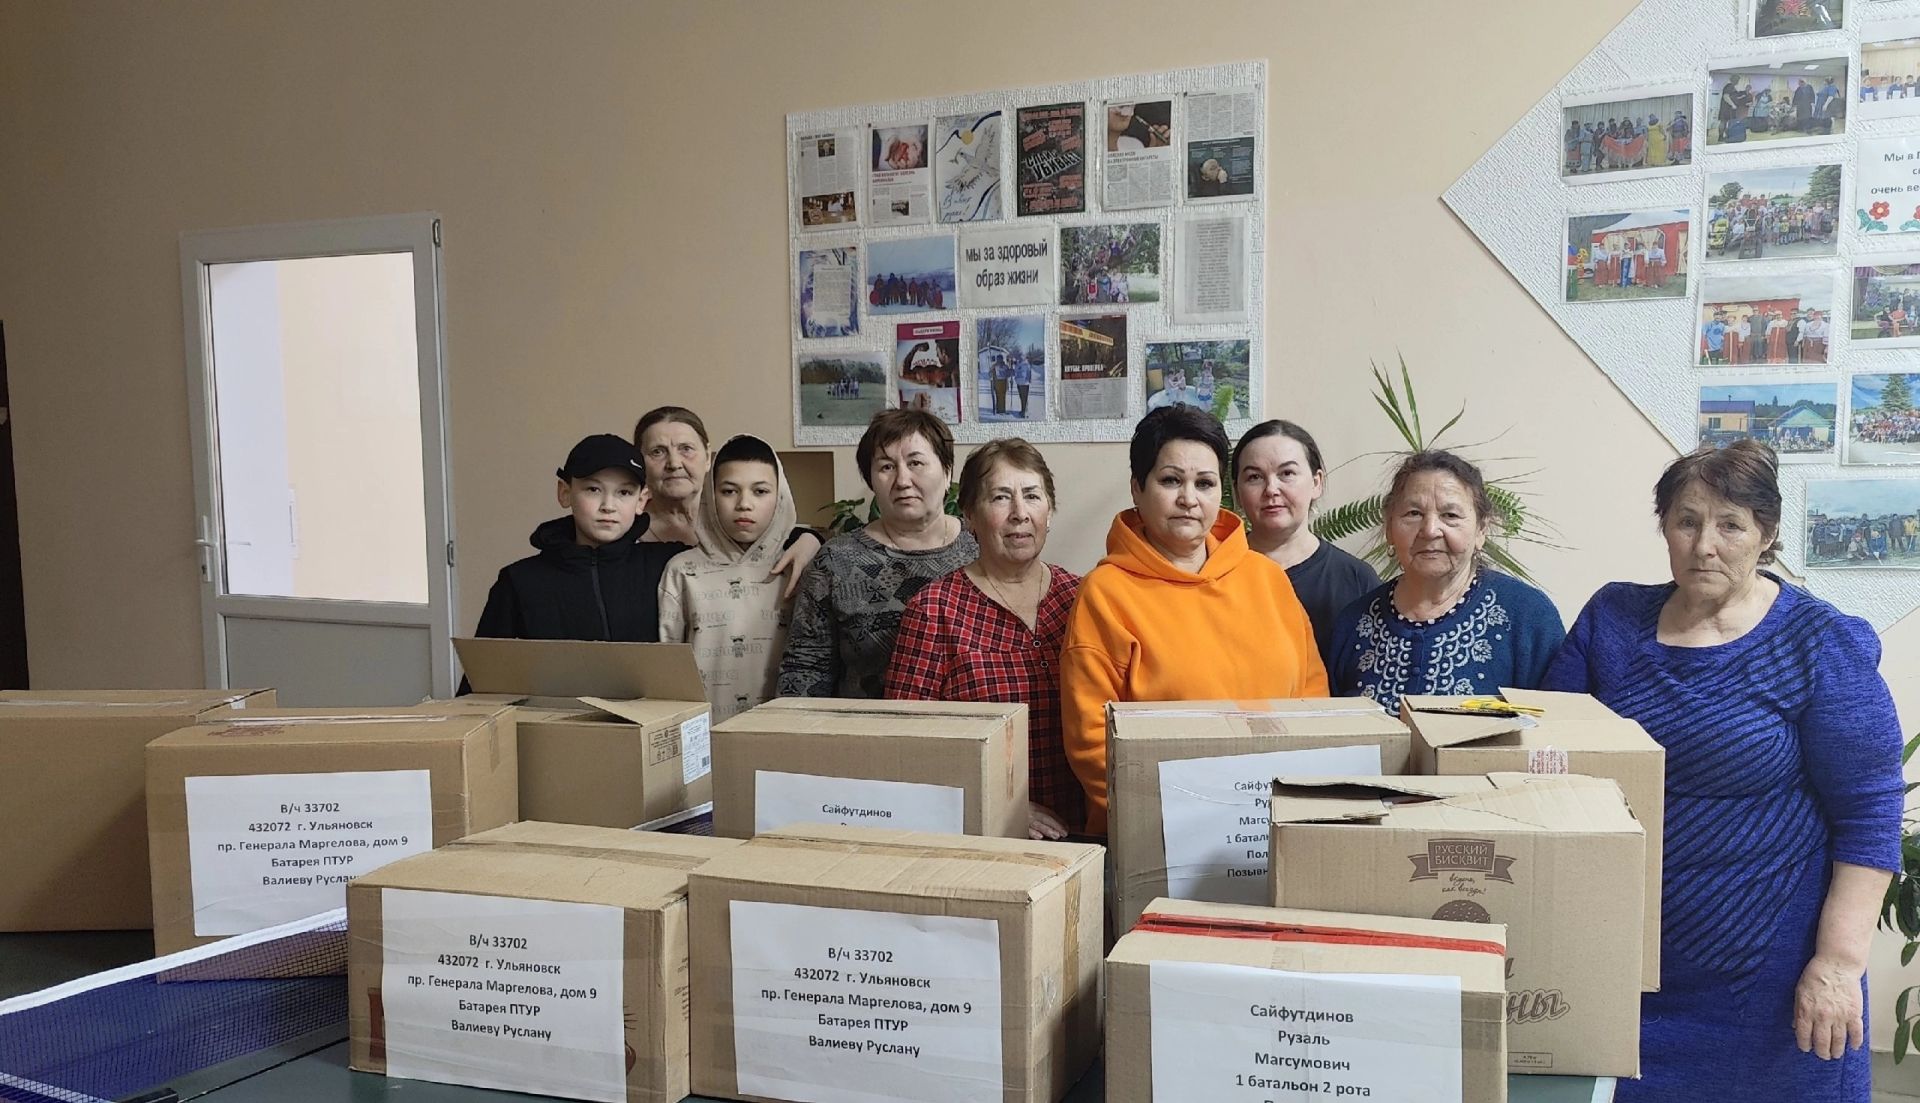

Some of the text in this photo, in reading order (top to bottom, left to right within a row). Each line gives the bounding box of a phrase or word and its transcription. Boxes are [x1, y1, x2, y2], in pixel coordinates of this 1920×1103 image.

[1884, 153, 1904, 162] Мы
[966, 238, 1048, 263] мы за здоровый
[976, 269, 1039, 291] образ жизни
[280, 803, 340, 815] В/ч 33702
[822, 804, 892, 818] Сайфутдинов
[248, 820, 373, 832] 432072 г. Ульяновск
[218, 836, 408, 853] пр. Генерала Маргелова, дом 9
[1226, 835, 1232, 843] 1
[1434, 844, 1488, 855] РУССКИЙ
[271, 855, 354, 869] Батарея ПТУР
[1434, 855, 1489, 866] БИСКВИТ
[262, 874, 360, 887] Валиеву Руслан
[469, 934, 528, 949] В/ч 33702
[828, 947, 893, 963] В/ч 33702
[438, 954, 561, 975] 432072 г. Ульяновск
[794, 968, 931, 988] 432072 г. Ульяновск
[408, 975, 597, 1000] пр. Генерала Маргелова, дом 9
[459, 1000, 541, 1017] Батарея ПТУР
[761, 989, 972, 1015] пр. Генерала Маргелова, дом 9
[818, 1014, 909, 1031] Батарея ПТУР
[1250, 1004, 1354, 1024] Сайфутдинов
[451, 1019, 552, 1042] Валиеву Руслану
[1278, 1030, 1330, 1046] Рузаль
[808, 1035, 920, 1058] Валиеву Руслану
[1254, 1052, 1350, 1072] Магсумович
[1235, 1074, 1371, 1098] 1 батальон 2 рота
